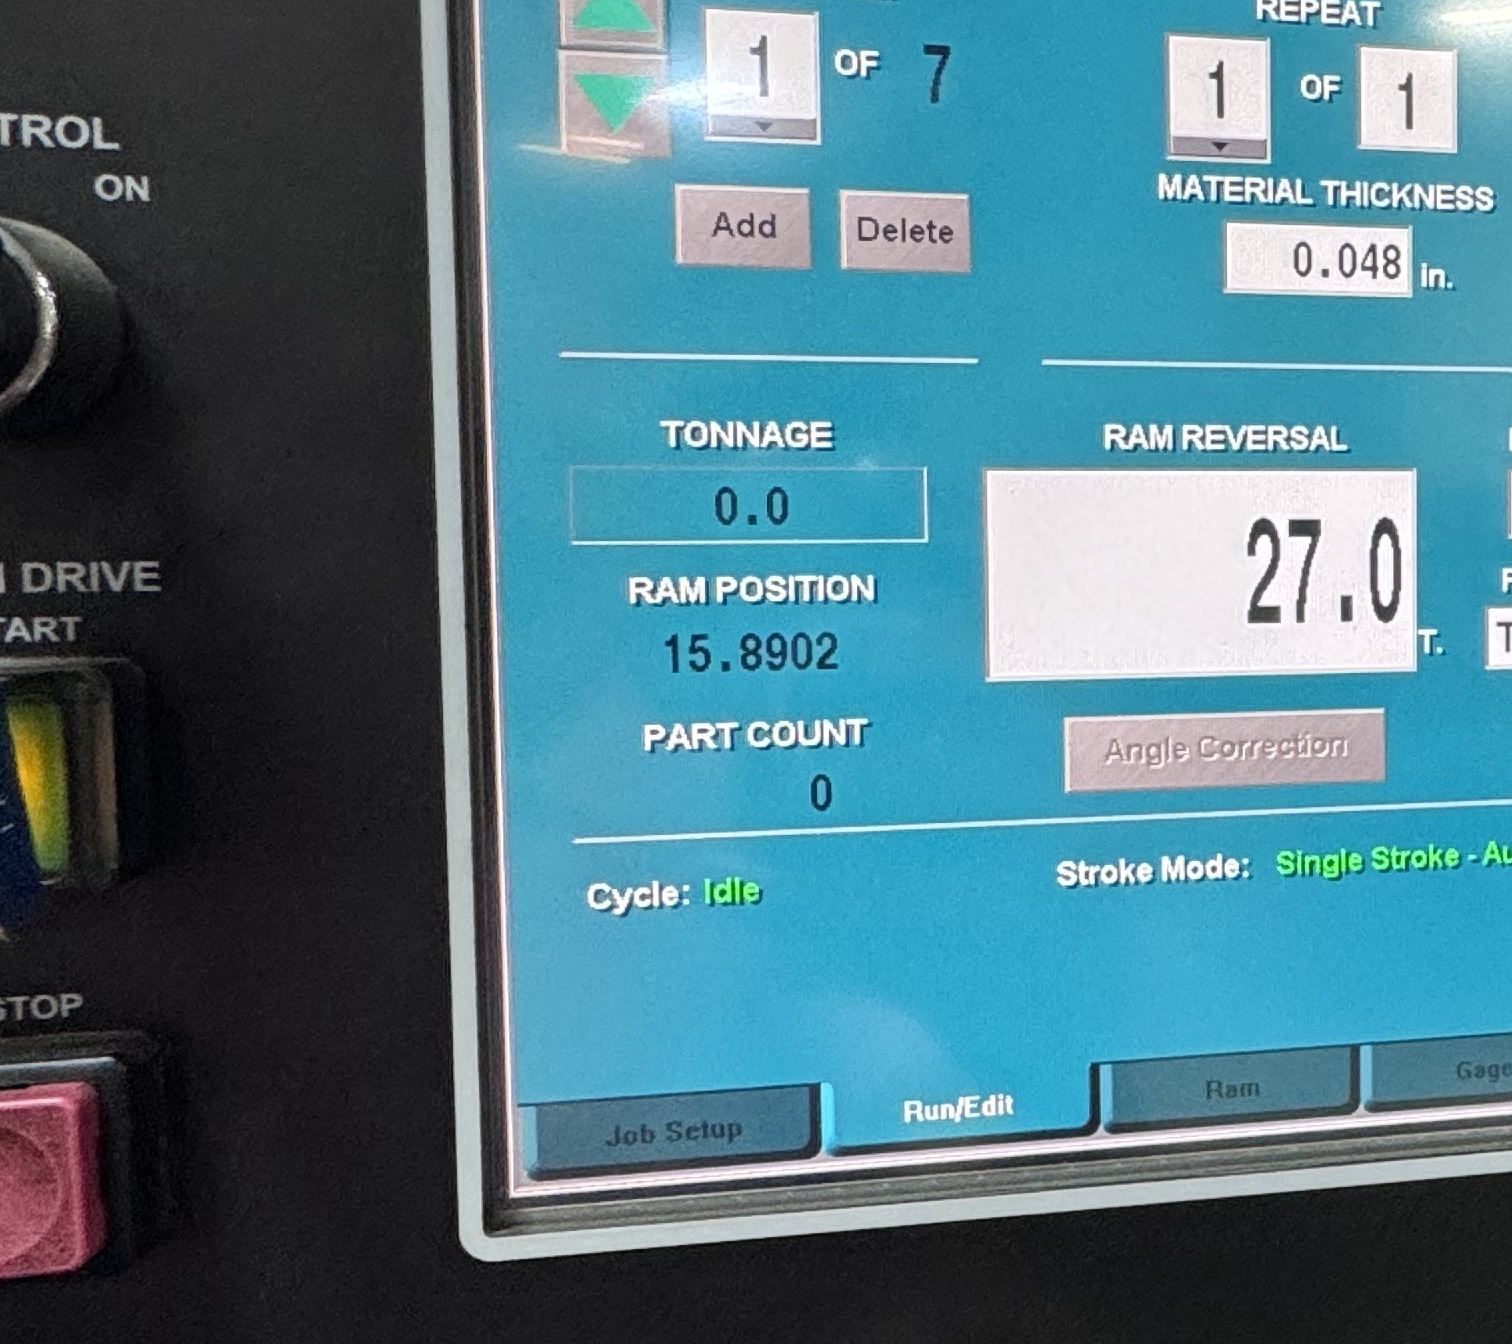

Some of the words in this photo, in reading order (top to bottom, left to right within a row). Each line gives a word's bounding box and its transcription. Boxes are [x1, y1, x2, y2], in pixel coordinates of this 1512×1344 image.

[748, 34, 769, 97] 1
[834, 49, 880, 77] OF
[922, 44, 951, 104] 7
[1208, 59, 1225, 119] 1
[1300, 74, 1342, 101] OF
[1397, 72, 1414, 130] 1
[94, 174, 150, 202] ON
[1158, 173, 1314, 205] MATERIAL
[1320, 179, 1496, 212] THICKNESS
[712, 210, 778, 240] Add
[857, 216, 954, 244] Delete
[1293, 240, 1402, 281] 0.048
[1420, 262, 1454, 289] in.
[660, 419, 834, 449] TONNAGE
[1104, 423, 1174, 452] RAM
[1182, 424, 1348, 453] REVERSAL
[714, 486, 790, 526] 0.0
[22, 560, 162, 594] DRIVE
[629, 576, 707, 604] RAM
[716, 574, 876, 604] POSITION
[1247, 516, 1402, 625] 27.0
[1418, 628, 1445, 656] T.
[664, 631, 840, 673] 15.8902
[643, 722, 739, 751] PART
[747, 718, 870, 747] COUNT
[1104, 735, 1191, 768] Angle
[1199, 732, 1350, 761] Correction
[810, 773, 833, 812] 0
[1056, 858, 1153, 888] Stroke
[1161, 855, 1251, 883] Mode:
[1276, 847, 1364, 879] Single
[1371, 843, 1460, 872] Stroke
[587, 881, 691, 916] Cycle:
[704, 877, 761, 905] Idle
[1455, 1058, 1512, 1084] Gage
[1206, 1078, 1261, 1100] Ram
[904, 1094, 1014, 1124] Run/Edit
[606, 1126, 656, 1148] Job
[666, 1120, 743, 1145] Setup
